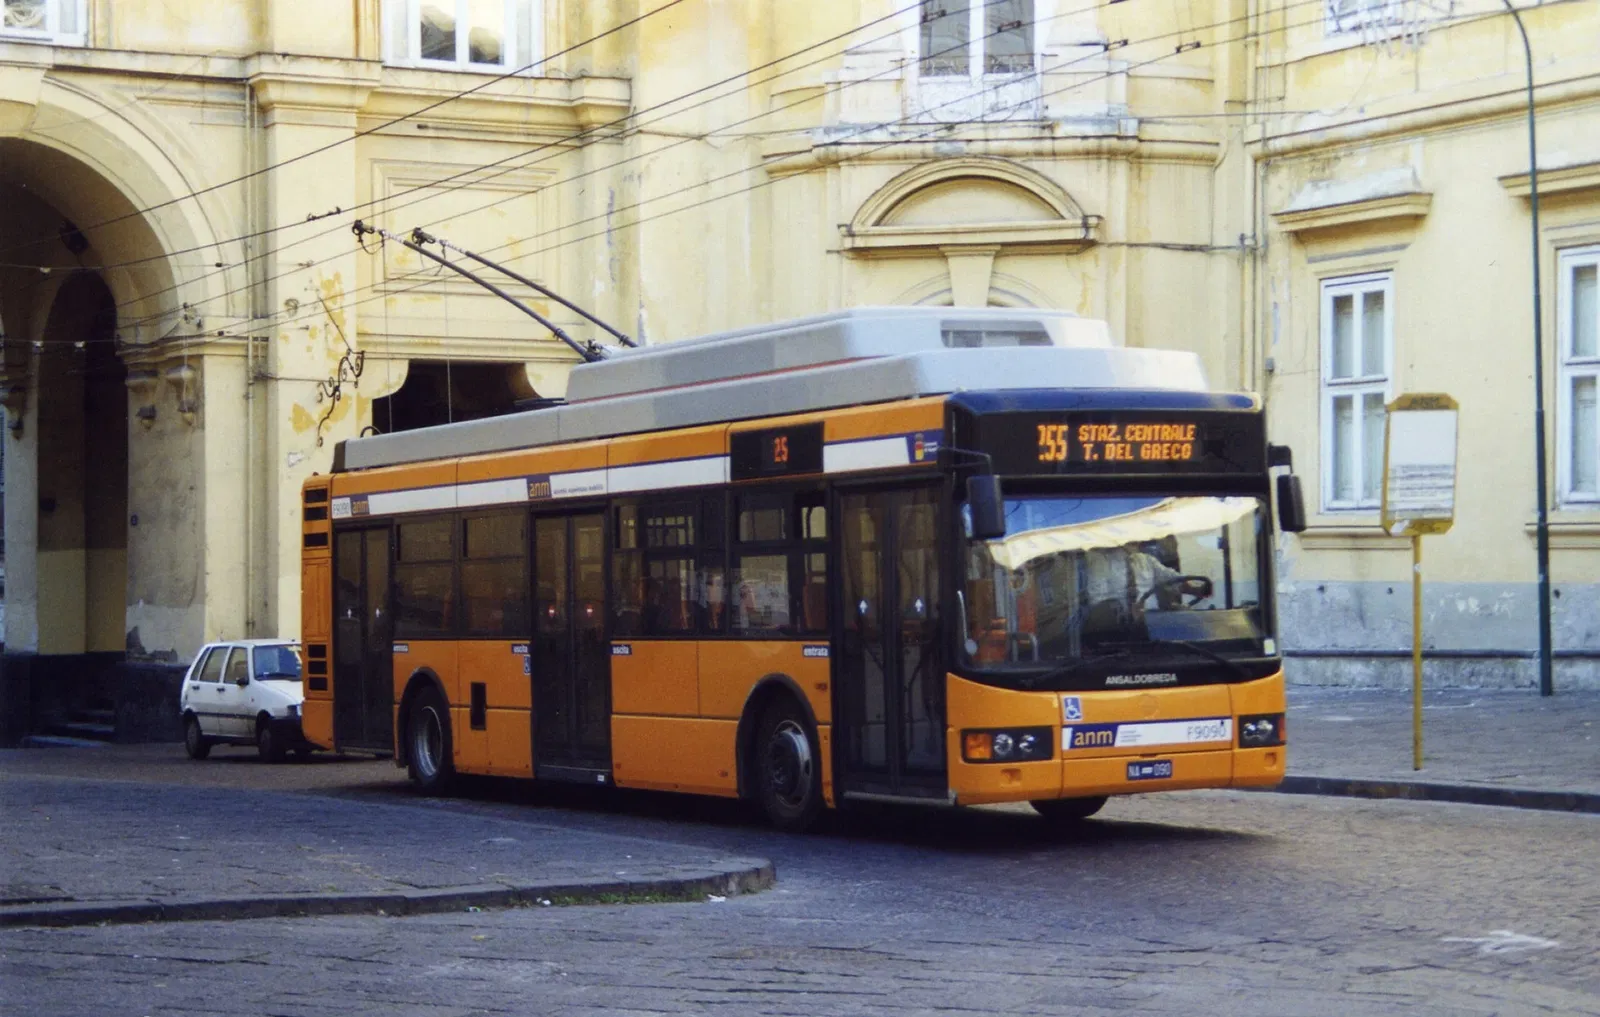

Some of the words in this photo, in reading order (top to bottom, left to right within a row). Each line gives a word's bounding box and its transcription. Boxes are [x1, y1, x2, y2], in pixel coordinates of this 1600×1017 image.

[1078, 424, 1121, 442] STAZ.
[1124, 424, 1196, 441] CENTRALE
[1083, 443, 1099, 461] T.
[1104, 443, 1134, 461] DEL
[1140, 443, 1193, 460] GRECO
[529, 481, 550, 497] anm
[803, 646, 829, 656] entrata
[1105, 673, 1177, 685] ANSALDOBREDA
[1074, 730, 1114, 746] anm
[1187, 724, 1227, 740] F9090
